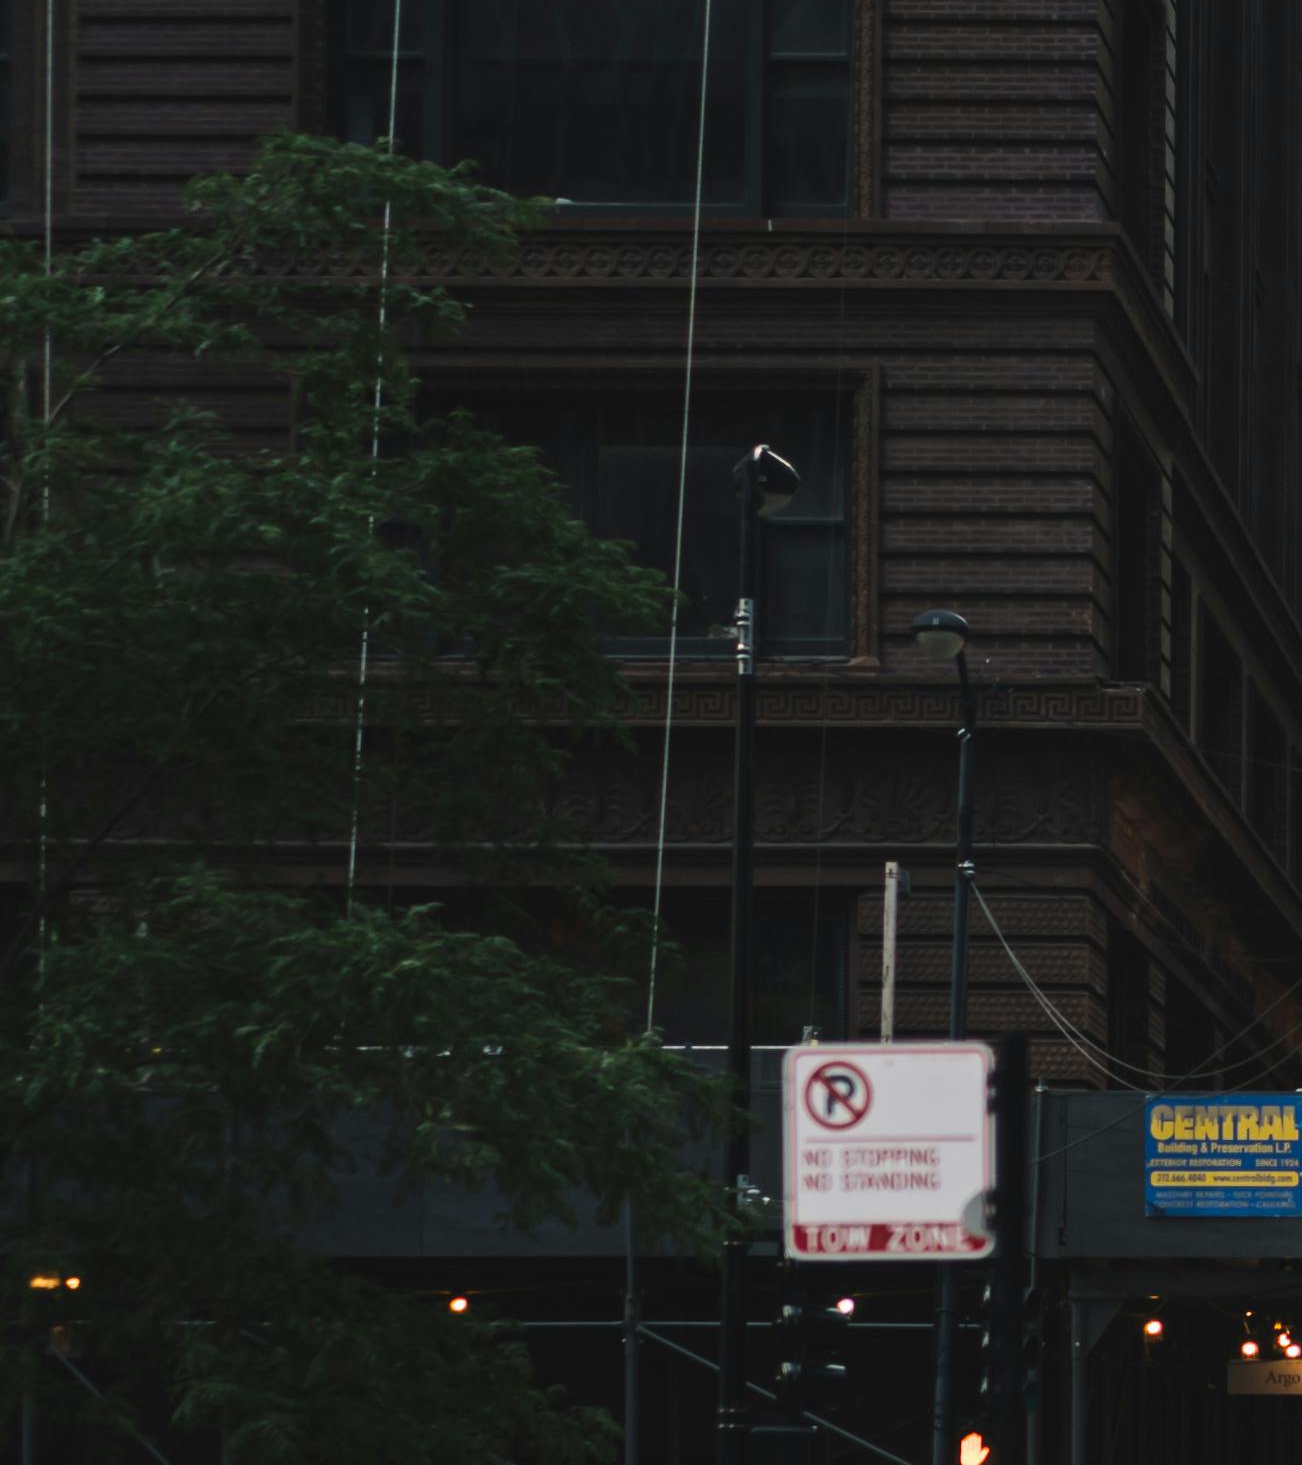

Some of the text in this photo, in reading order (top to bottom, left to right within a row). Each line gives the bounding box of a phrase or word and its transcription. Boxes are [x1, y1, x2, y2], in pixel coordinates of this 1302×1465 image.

[1150, 1104, 1300, 1141] CENTRAL
[803, 1148, 940, 1167] NO STOPPING
[1157, 1142, 1198, 1155] Building
[1200, 1143, 1208, 1153] &
[1210, 1142, 1273, 1153] Preservation
[803, 1172, 942, 1191] NO STANDING
[805, 1226, 972, 1253] TOW ZONE
[1265, 1371, 1300, 1387] Argo
